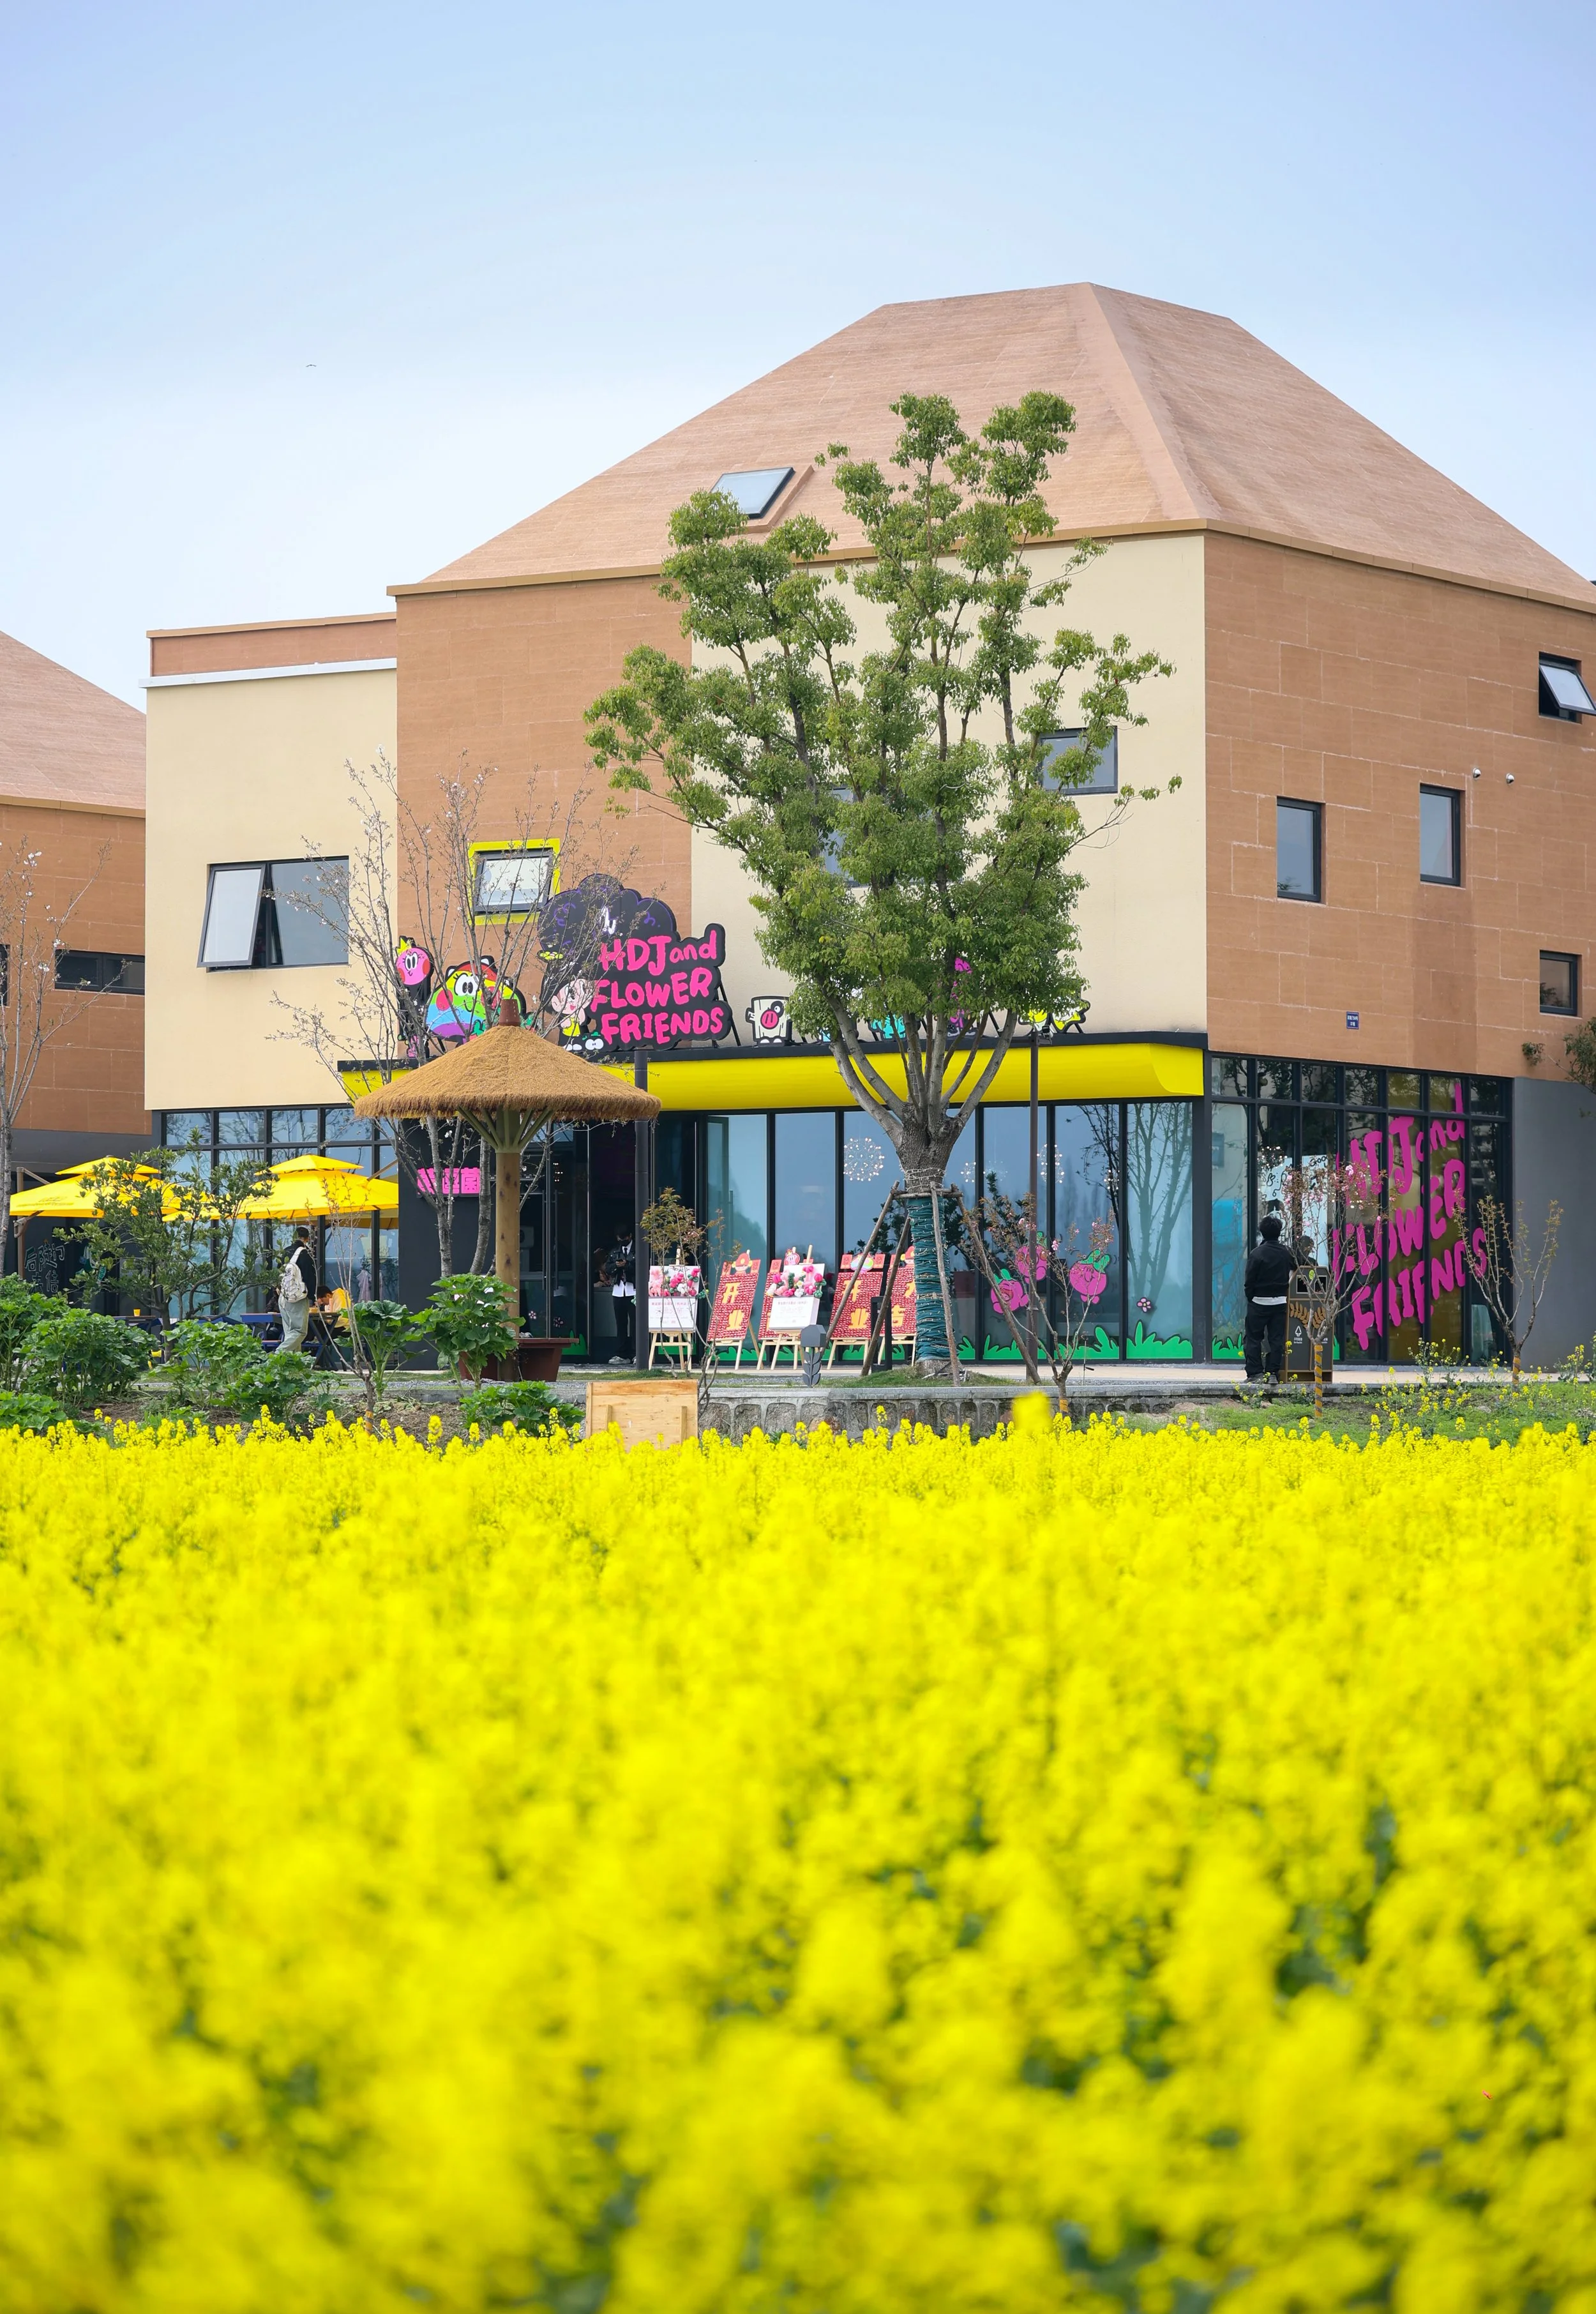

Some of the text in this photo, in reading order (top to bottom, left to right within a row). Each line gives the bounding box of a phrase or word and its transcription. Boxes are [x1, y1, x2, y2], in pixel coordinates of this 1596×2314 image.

[598, 930, 717, 976] HDJ and
[591, 967, 712, 1012] FLOWER
[601, 1007, 724, 1045] FRIENDS
[721, 1282, 744, 1331] 开业
